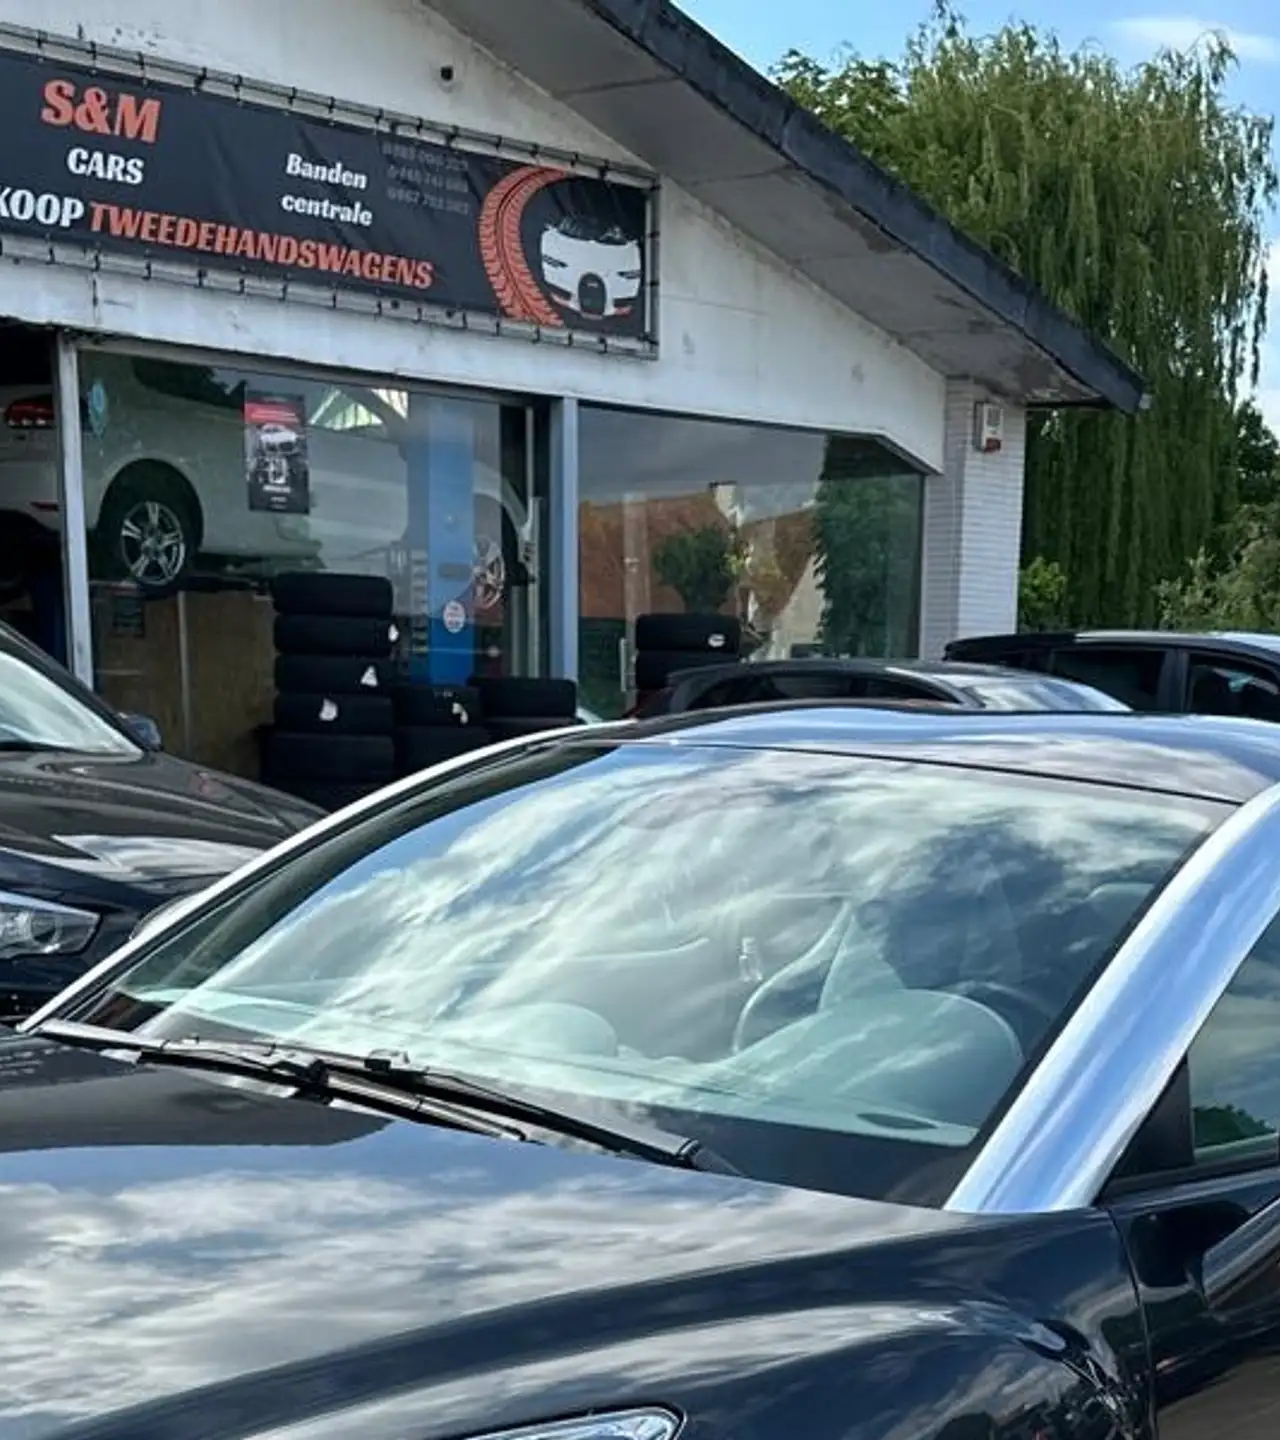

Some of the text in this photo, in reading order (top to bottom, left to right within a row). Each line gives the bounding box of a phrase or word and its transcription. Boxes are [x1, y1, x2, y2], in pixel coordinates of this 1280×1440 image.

[41, 79, 162, 144] S&M
[67, 147, 145, 185] CARS
[286, 152, 368, 190] Banden
[281, 194, 374, 226] centrale
[89, 201, 435, 289] TWEEDEHANDSWAGENS
